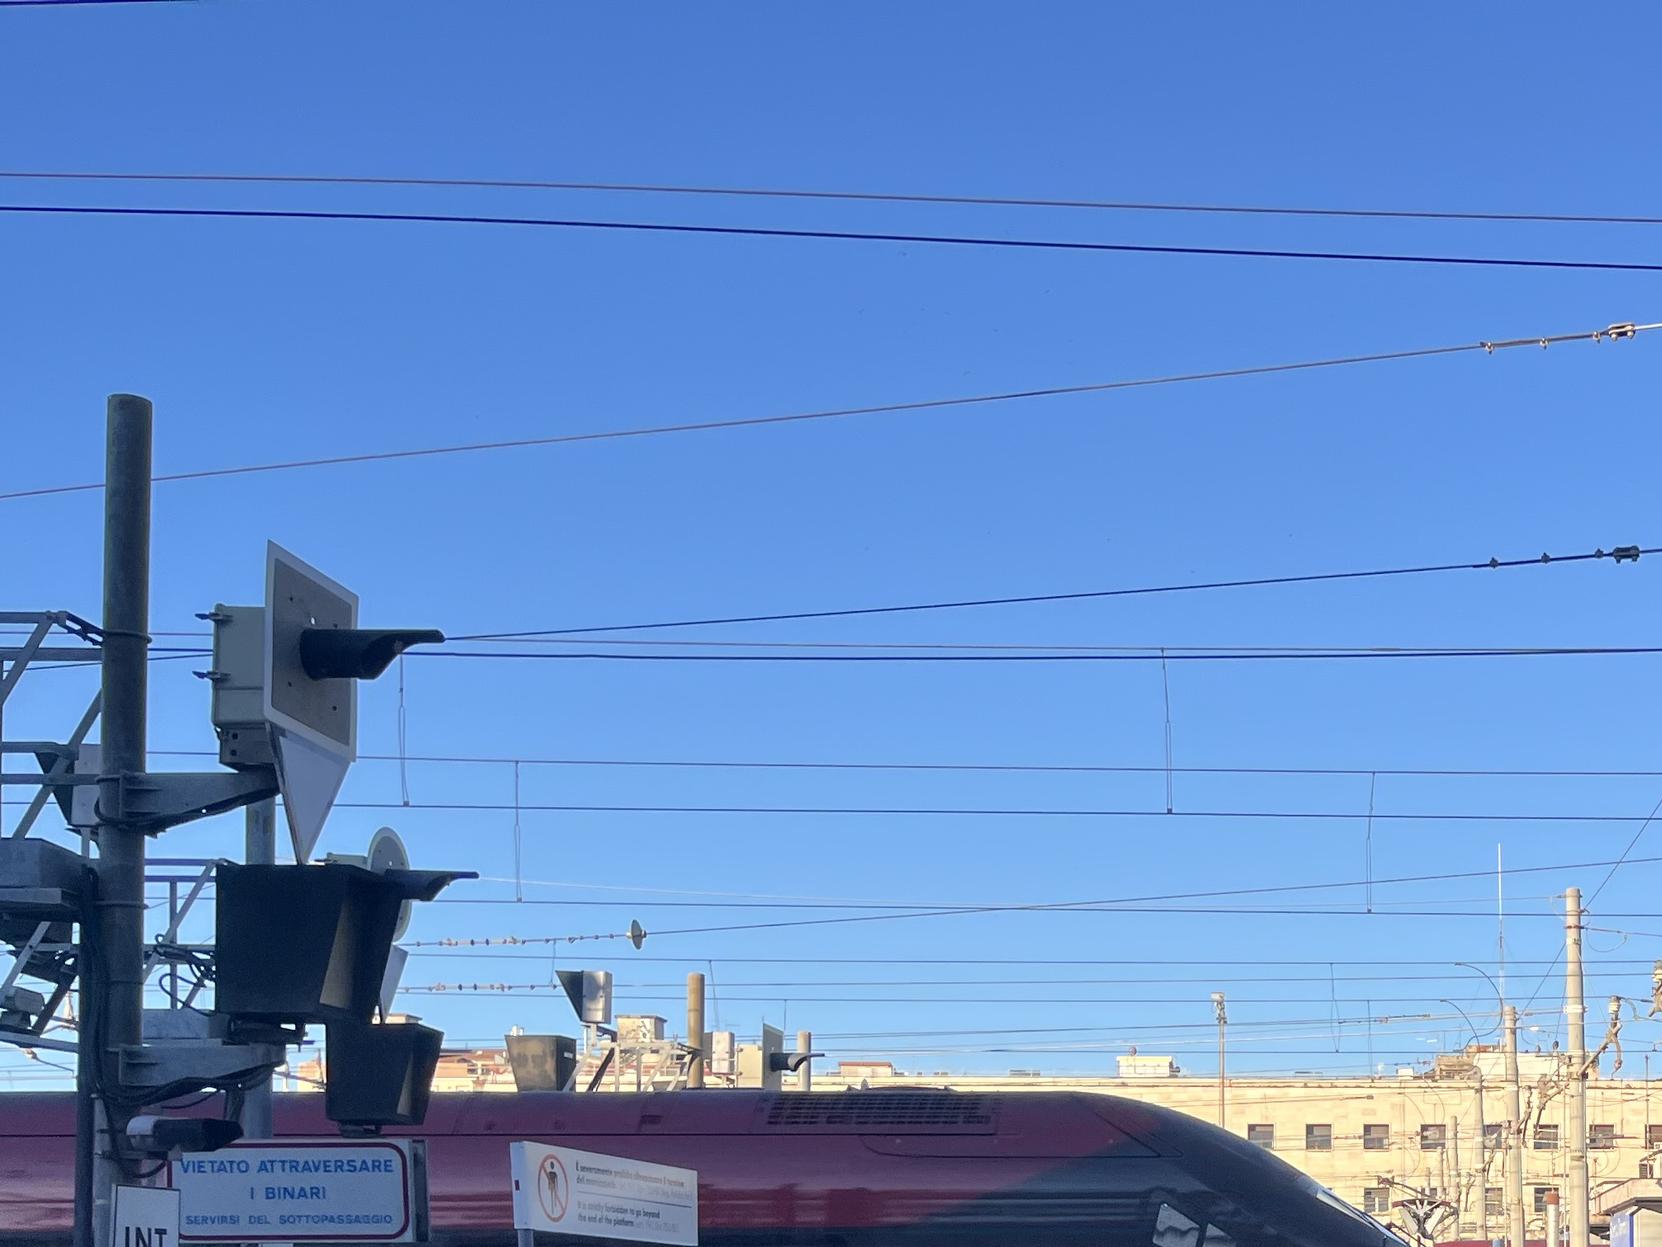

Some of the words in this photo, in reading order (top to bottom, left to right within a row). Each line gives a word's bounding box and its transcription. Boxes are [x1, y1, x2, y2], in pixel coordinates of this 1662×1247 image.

[181, 1159, 250, 1174] VIETATO
[257, 1159, 394, 1174] ATTRAVERSARE
[250, 1186, 255, 1200] I
[264, 1186, 327, 1201] BINARI
[185, 1214, 240, 1226] SERVIRSI
[248, 1214, 271, 1226] DEL
[279, 1214, 393, 1226] SOTTOPASSAGGIO
